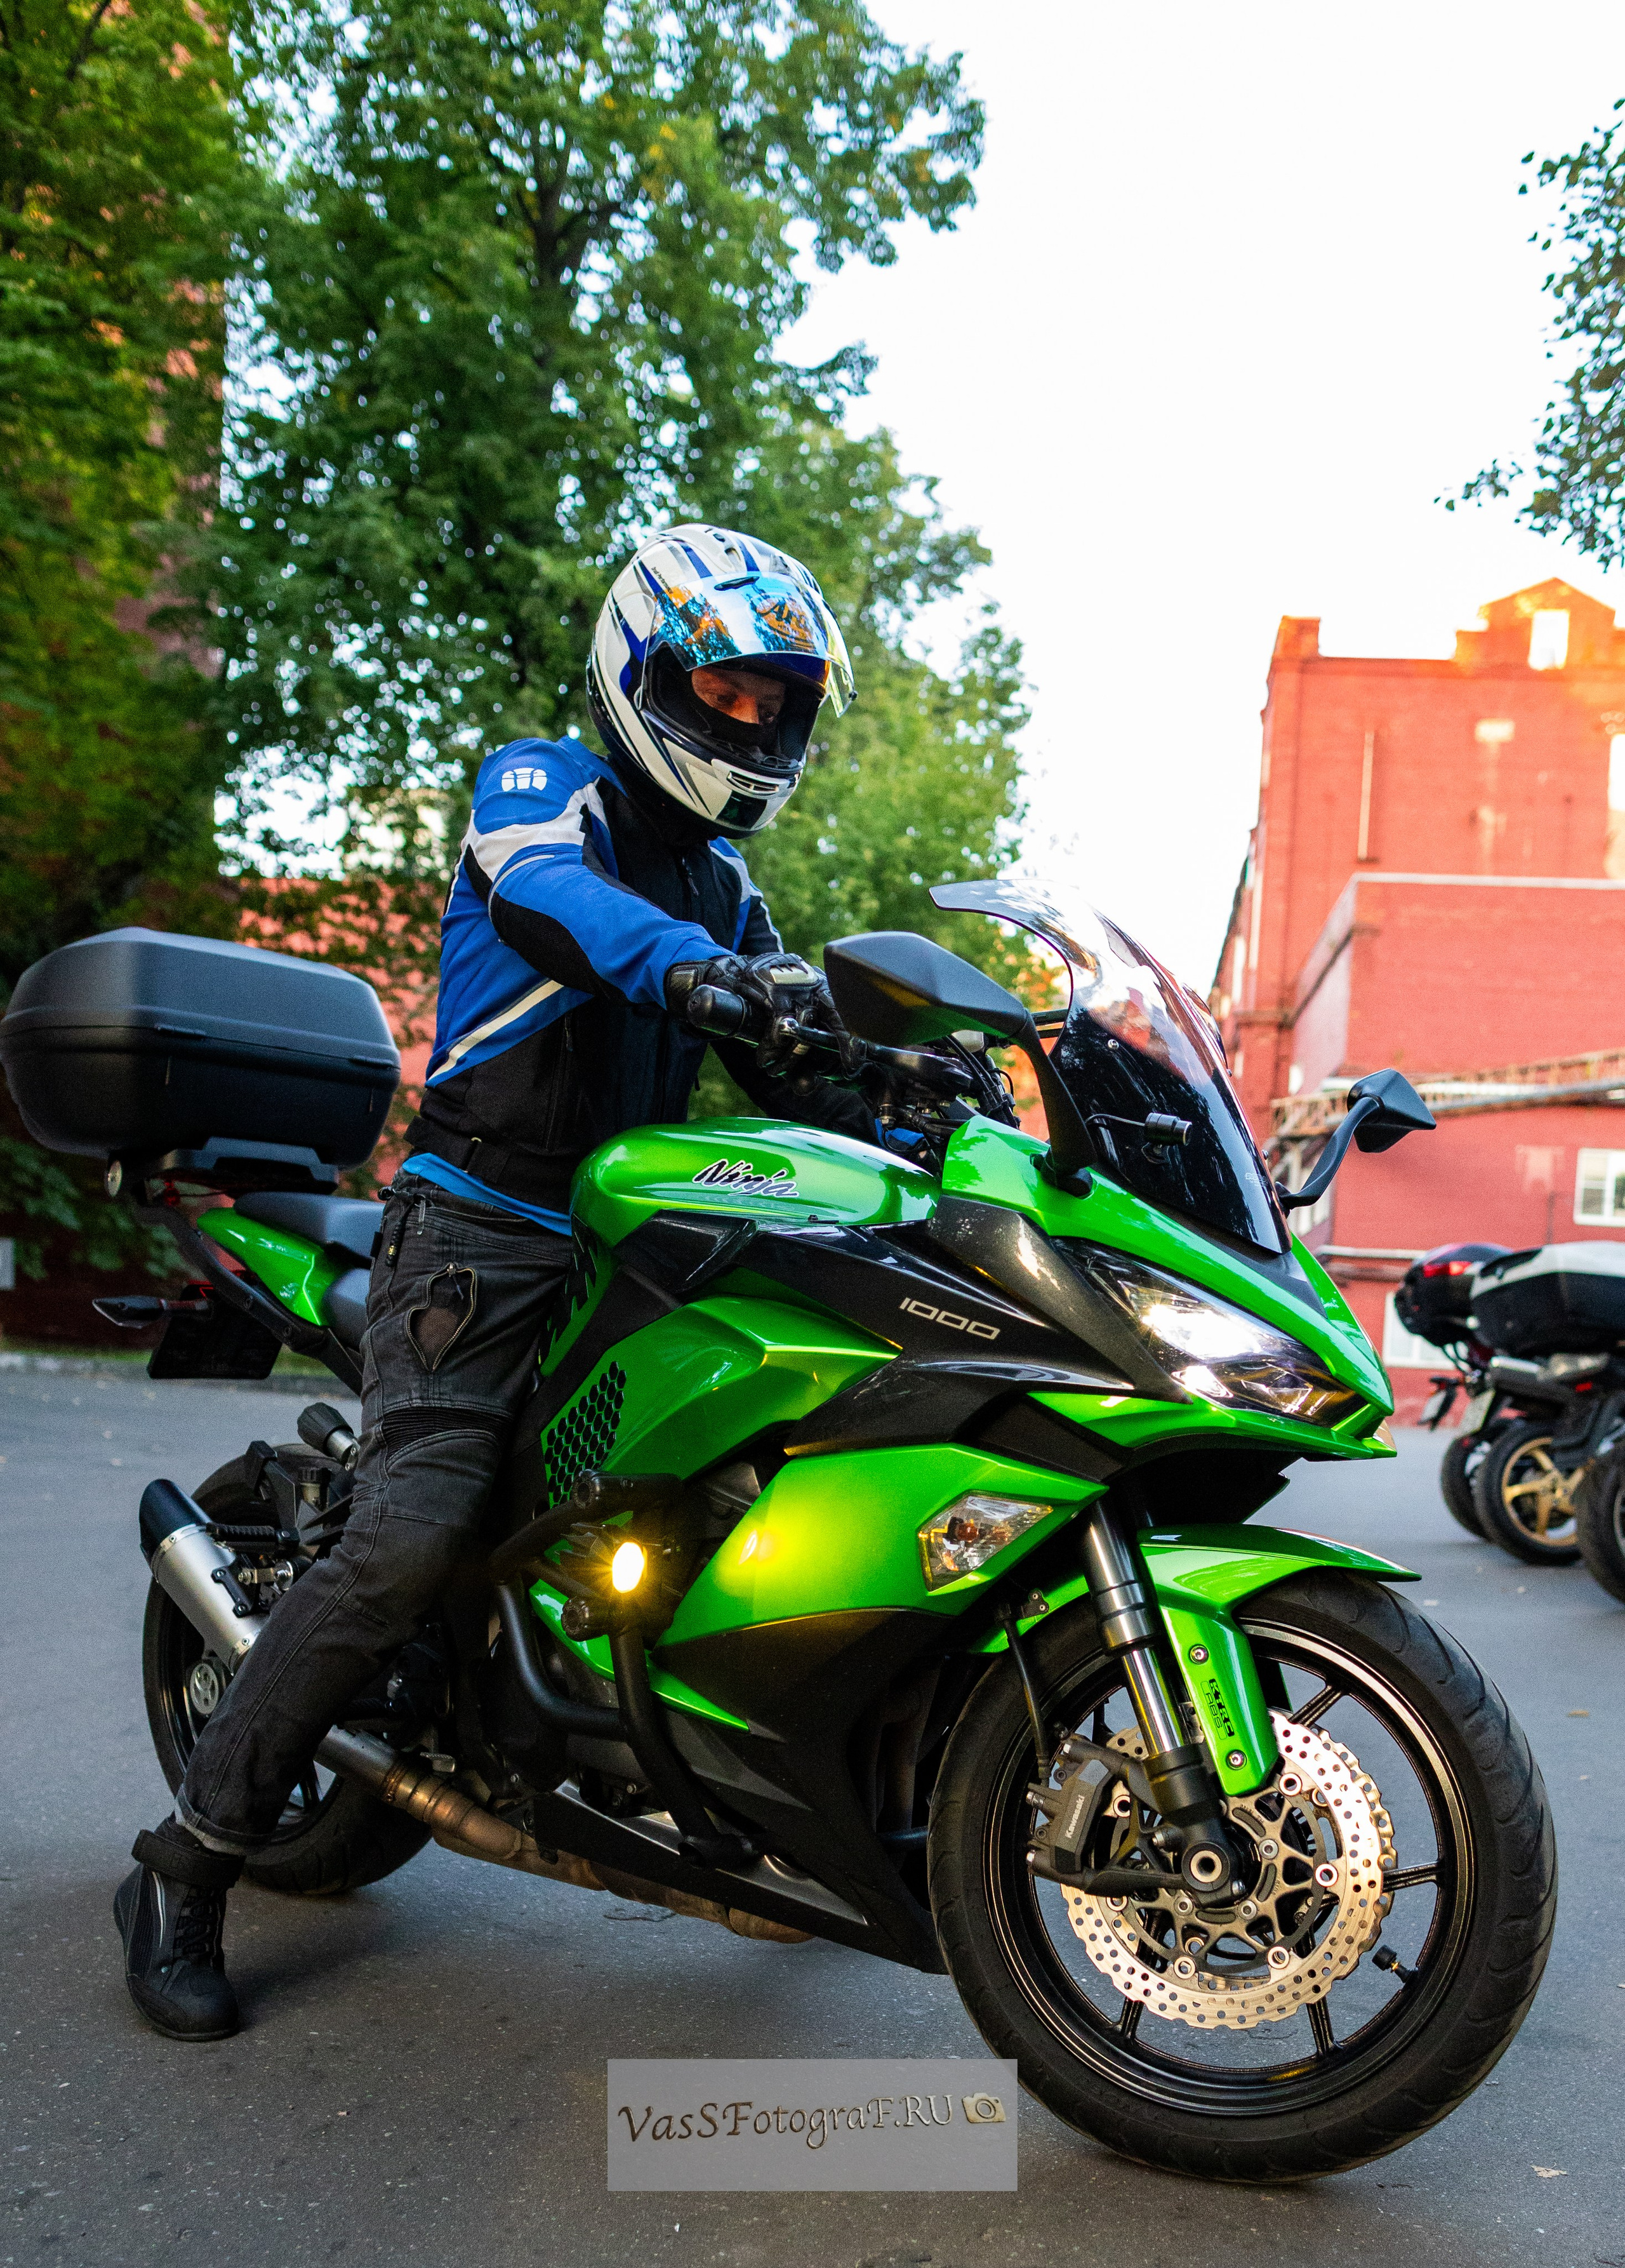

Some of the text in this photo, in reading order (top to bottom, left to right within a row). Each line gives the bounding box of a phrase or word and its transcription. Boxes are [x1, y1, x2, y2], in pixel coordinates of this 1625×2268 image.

[693, 1159, 799, 1196] Ninja
[899, 1297, 1000, 1340] 1000
[1205, 1692, 1223, 1729] ABS
[1209, 1680, 1234, 1734] KTRC
[1065, 1794, 1085, 1838] Kawasaki
